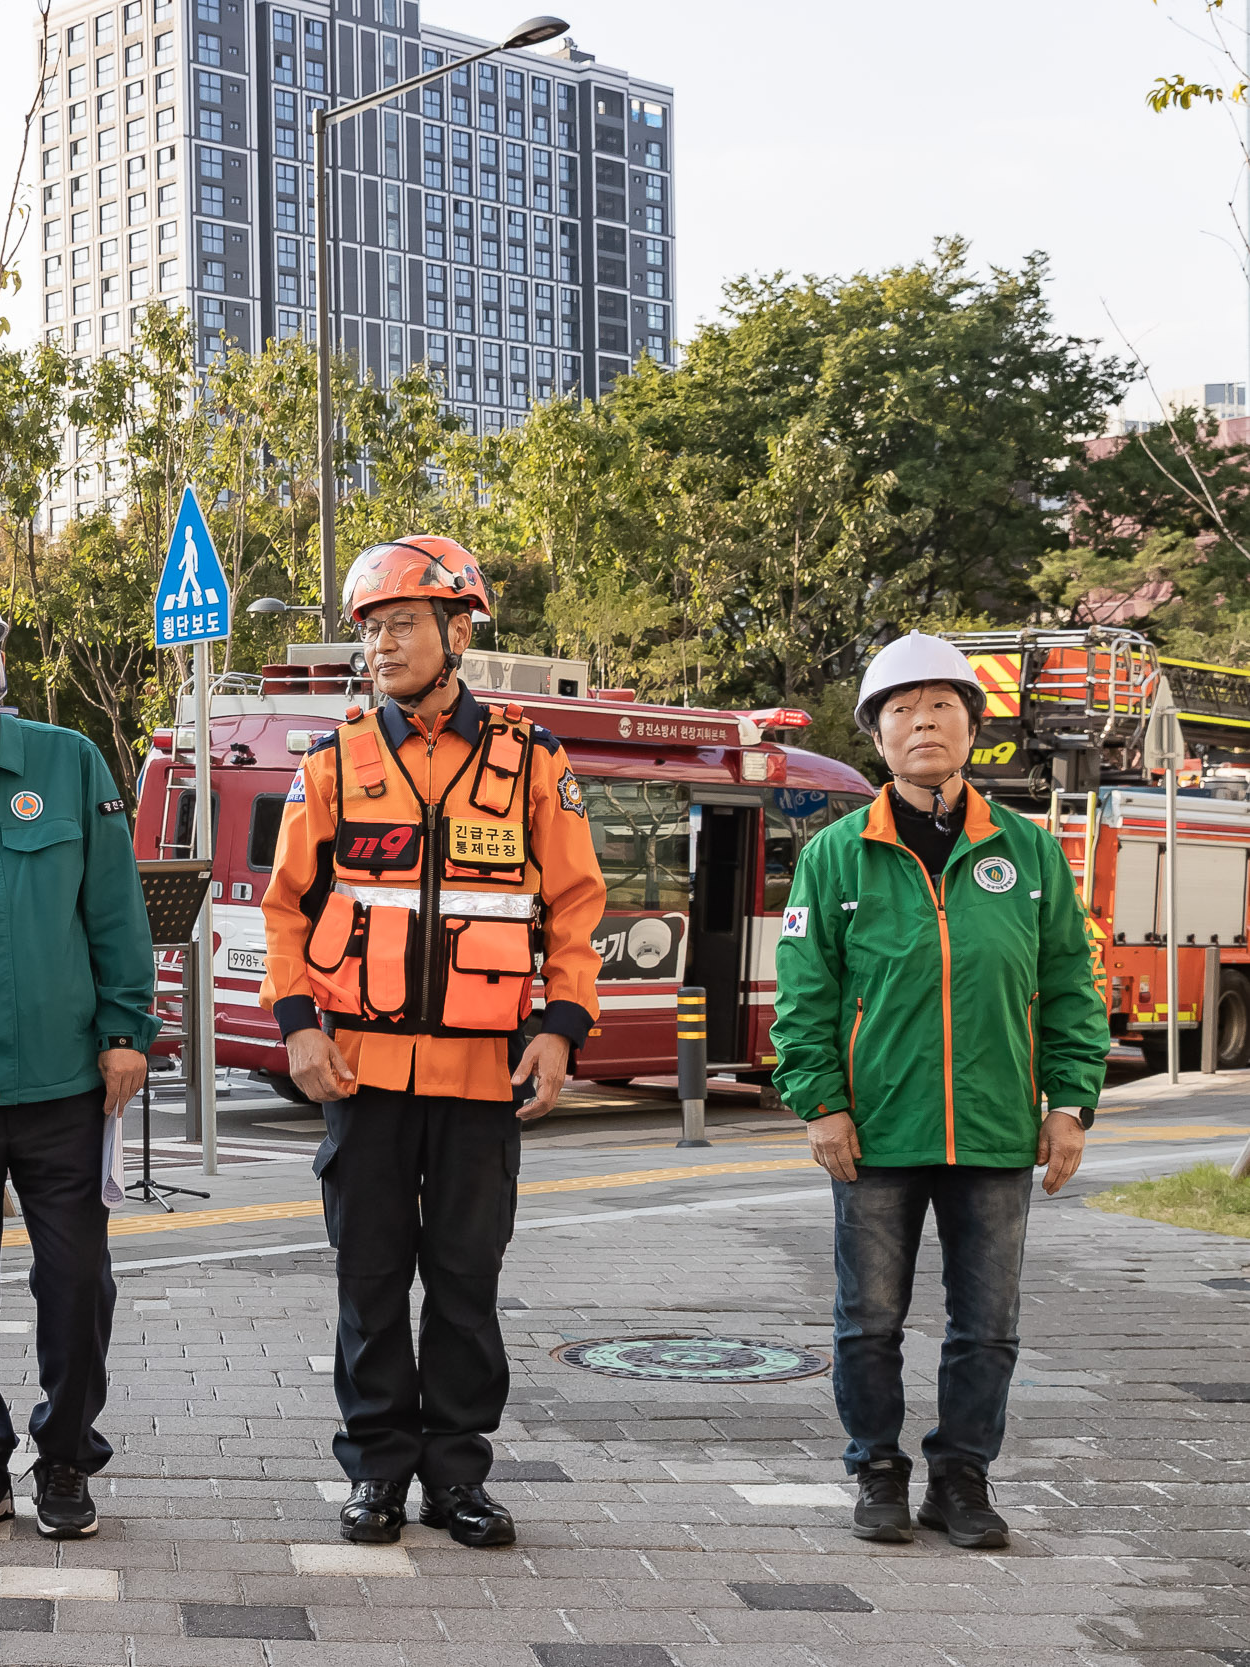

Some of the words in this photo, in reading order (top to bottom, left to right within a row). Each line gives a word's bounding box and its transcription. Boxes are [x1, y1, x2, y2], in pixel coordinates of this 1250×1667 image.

[162, 612, 220, 640] 횡단보도
[636, 722, 678, 739] 광진소방서
[680, 725, 727, 742] 현장지휘본부
[970, 741, 1017, 765] 119
[347, 826, 413, 859] 119
[455, 825, 516, 842] 긴급구조
[455, 840, 517, 857] 통제단장
